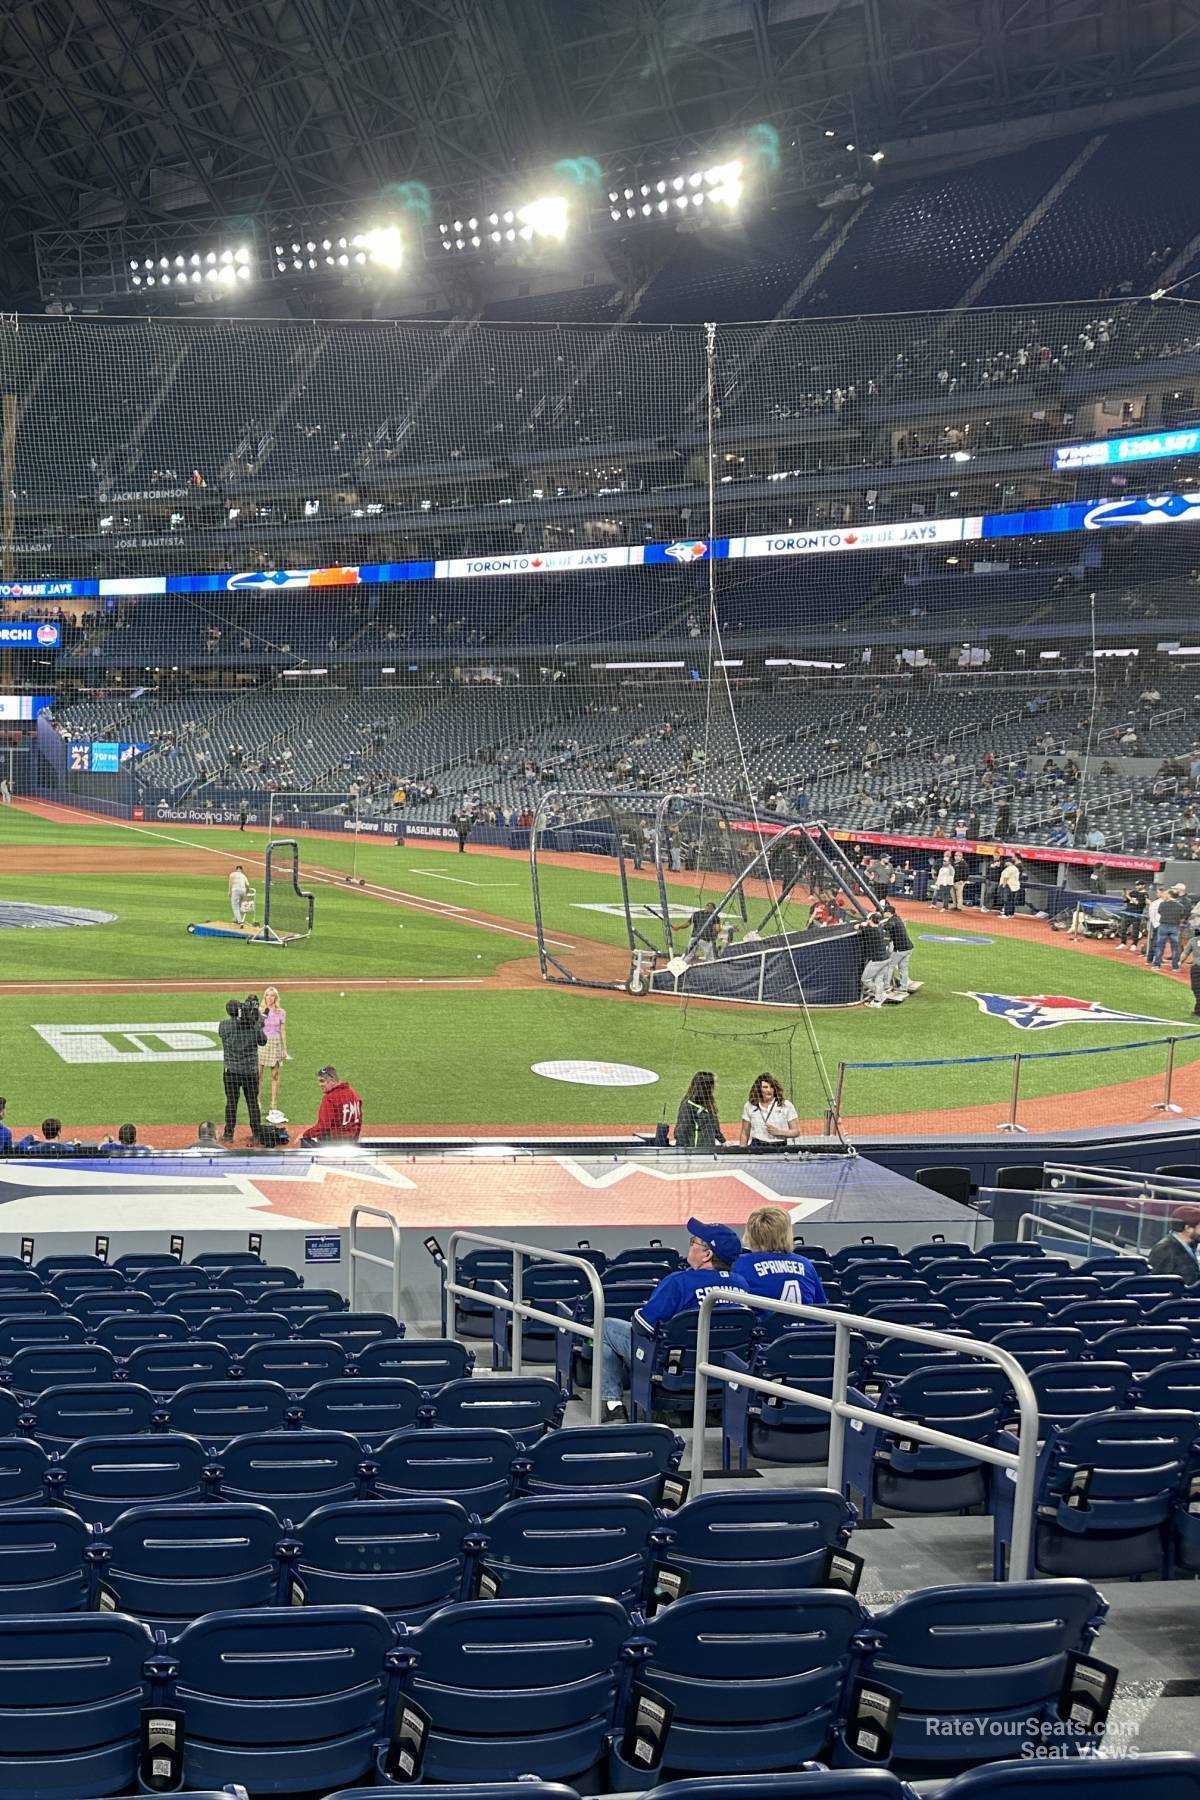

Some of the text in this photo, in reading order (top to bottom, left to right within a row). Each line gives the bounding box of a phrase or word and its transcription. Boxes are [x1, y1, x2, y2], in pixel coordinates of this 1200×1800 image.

[112, 492, 140, 501] JACKIE
[143, 489, 188, 500] ROBINSON
[141, 537, 184, 548] BAUTISTA
[766, 534, 841, 551] TORONTO
[900, 526, 937, 541] JAYS
[9, 543, 52, 553] HALLADAY
[466, 558, 528, 573] TORONTO
[577, 553, 608, 566] JAYS
[22, 585, 46, 594] BLUE
[48, 584, 72, 594] JAYS
[72, 746, 90, 754] MAY
[71, 753, 89, 770] 21
[156, 808, 187, 819] Official
[189, 810, 222, 823] Roofing
[343, 820, 379, 831] theScore
[384, 822, 398, 833] BET
[406, 825, 442, 836] BASELINE
[60, 1030, 224, 1053] TD
[753, 1258, 805, 1277] SPRINGER
[779, 1280, 802, 1305] 4
